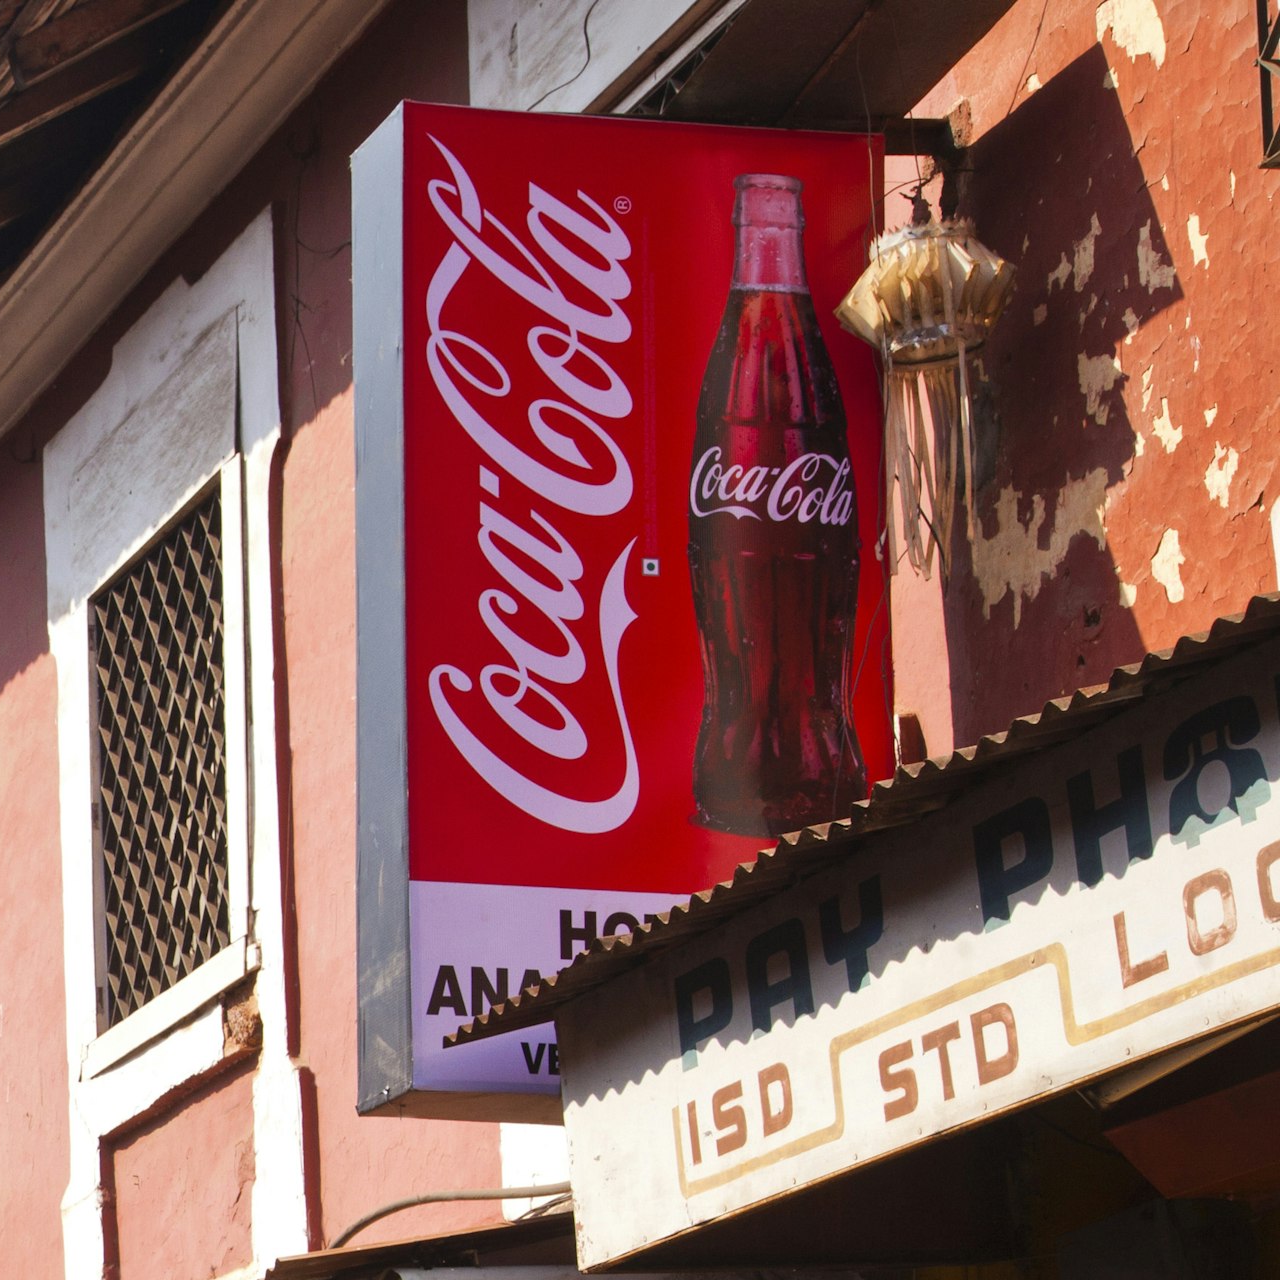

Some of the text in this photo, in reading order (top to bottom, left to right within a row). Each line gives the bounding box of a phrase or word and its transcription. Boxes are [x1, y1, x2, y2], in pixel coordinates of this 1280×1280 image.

[674, 873, 884, 1072] PAY
[686, 1062, 793, 1167] ISD
[877, 1002, 1020, 1123] STD
